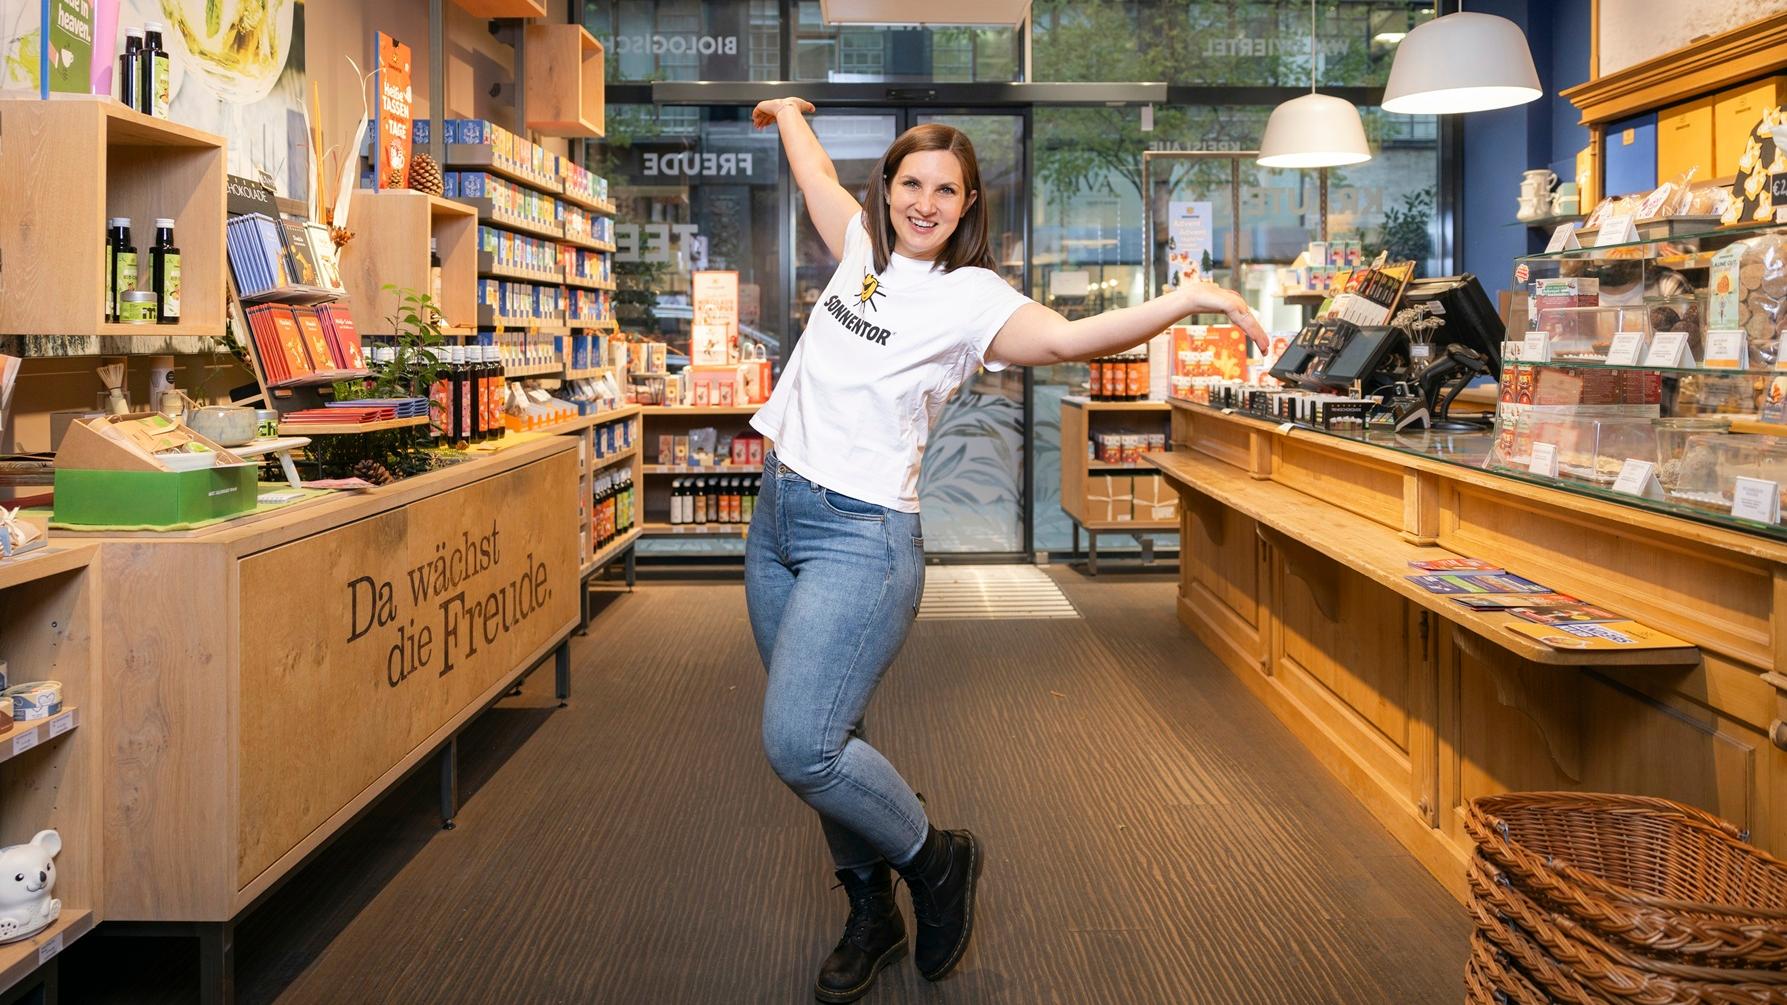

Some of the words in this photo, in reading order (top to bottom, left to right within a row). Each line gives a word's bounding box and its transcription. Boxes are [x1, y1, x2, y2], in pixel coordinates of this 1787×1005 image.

[58, 3, 91, 42] heaven.
[383, 96, 410, 119] TASSEN
[389, 119, 407, 139] TAGE
[347, 576, 397, 644] Da
[407, 519, 500, 607] wächst
[387, 618, 432, 688] die
[439, 552, 552, 678] Freude.
